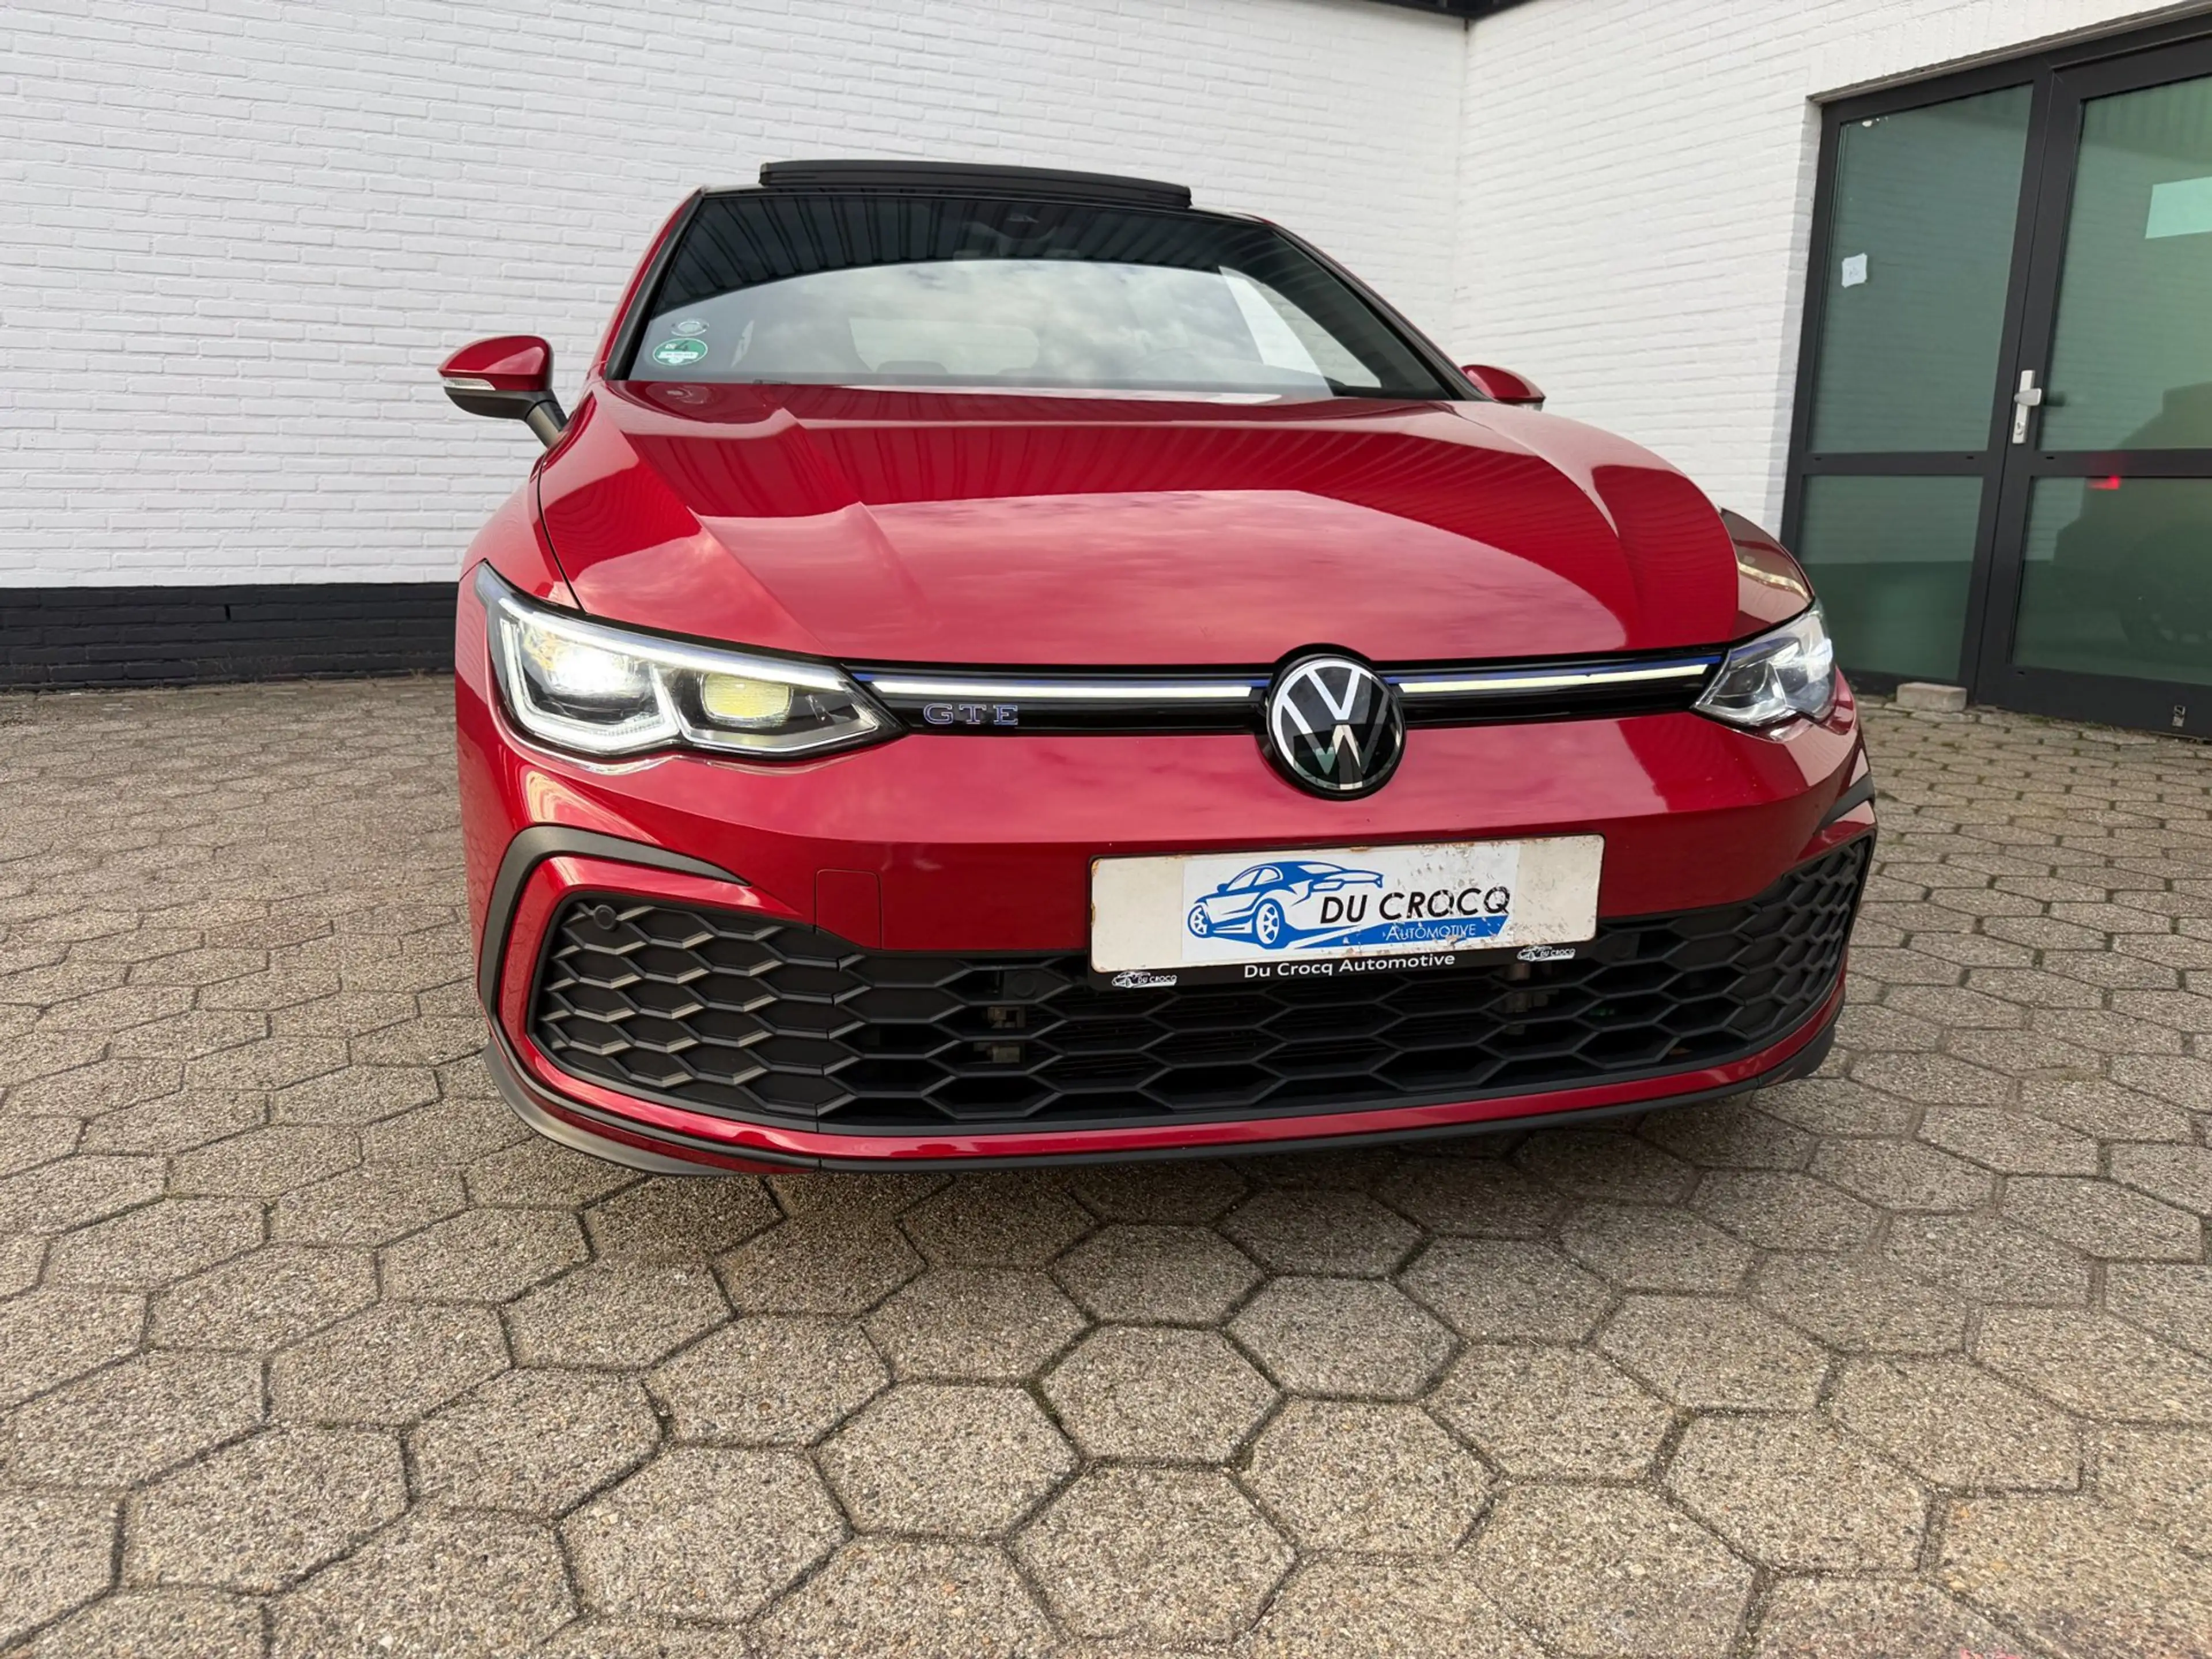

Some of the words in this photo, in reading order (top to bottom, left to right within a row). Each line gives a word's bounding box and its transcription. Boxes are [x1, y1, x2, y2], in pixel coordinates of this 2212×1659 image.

[923, 703, 1018, 725] GTE
[1320, 895, 1368, 924] DU
[1379, 886, 1510, 920] CROCQ
[1244, 965, 1270, 978] Du
[1277, 963, 1332, 976] Crocq
[1339, 954, 1455, 972] Automotive
